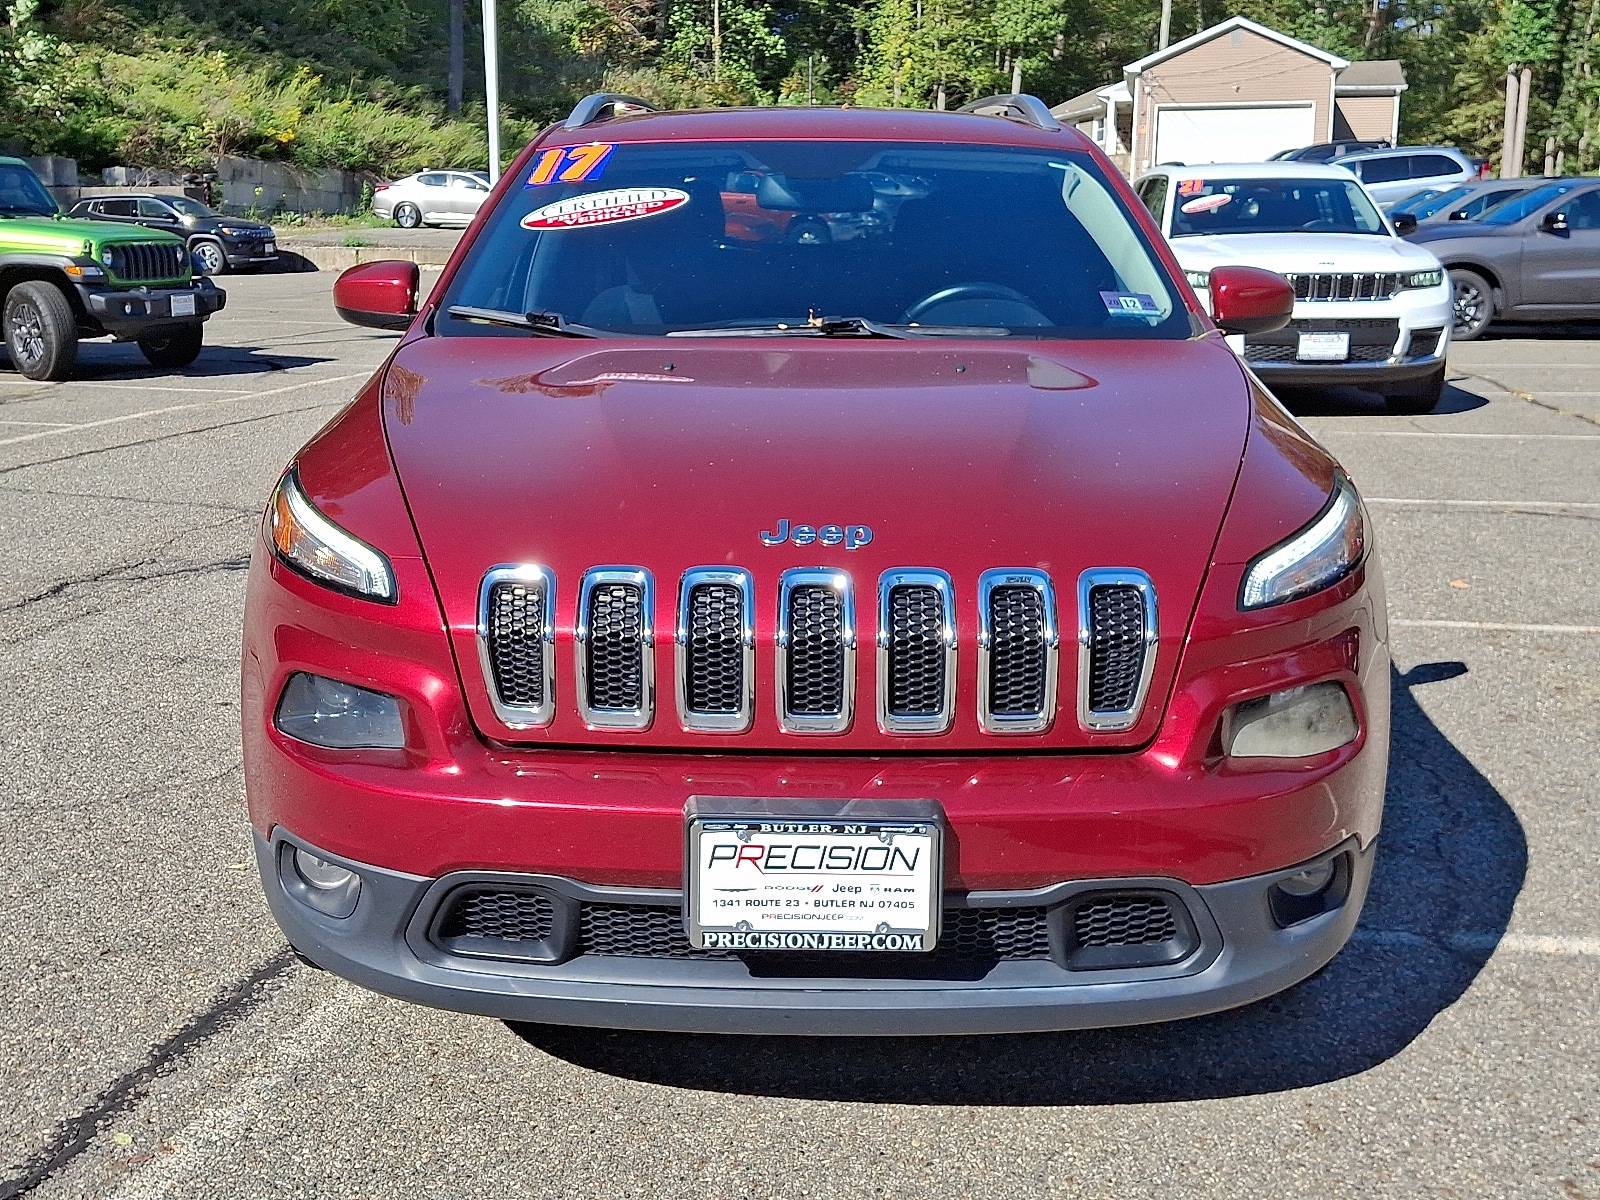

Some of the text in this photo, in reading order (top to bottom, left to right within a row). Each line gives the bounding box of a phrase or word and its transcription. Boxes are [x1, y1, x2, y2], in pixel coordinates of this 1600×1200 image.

[528, 144, 613, 185] 17
[1178, 180, 1203, 194] 21
[541, 189, 667, 216] CERTIFIED
[546, 201, 665, 224] PRE-OWNED
[564, 207, 648, 225] VEHICLE
[1122, 299, 1139, 308] 12
[759, 518, 875, 550] Jeep
[760, 823, 838, 833] BUTLER,
[844, 825, 868, 834] NJ
[708, 844, 920, 872] PRECISION
[832, 884, 862, 895] Jeep
[713, 899, 915, 909] 1341 ROUTE 23 BUTLER NJ 07405
[702, 931, 923, 951] PRECISIONJEEP.COM
